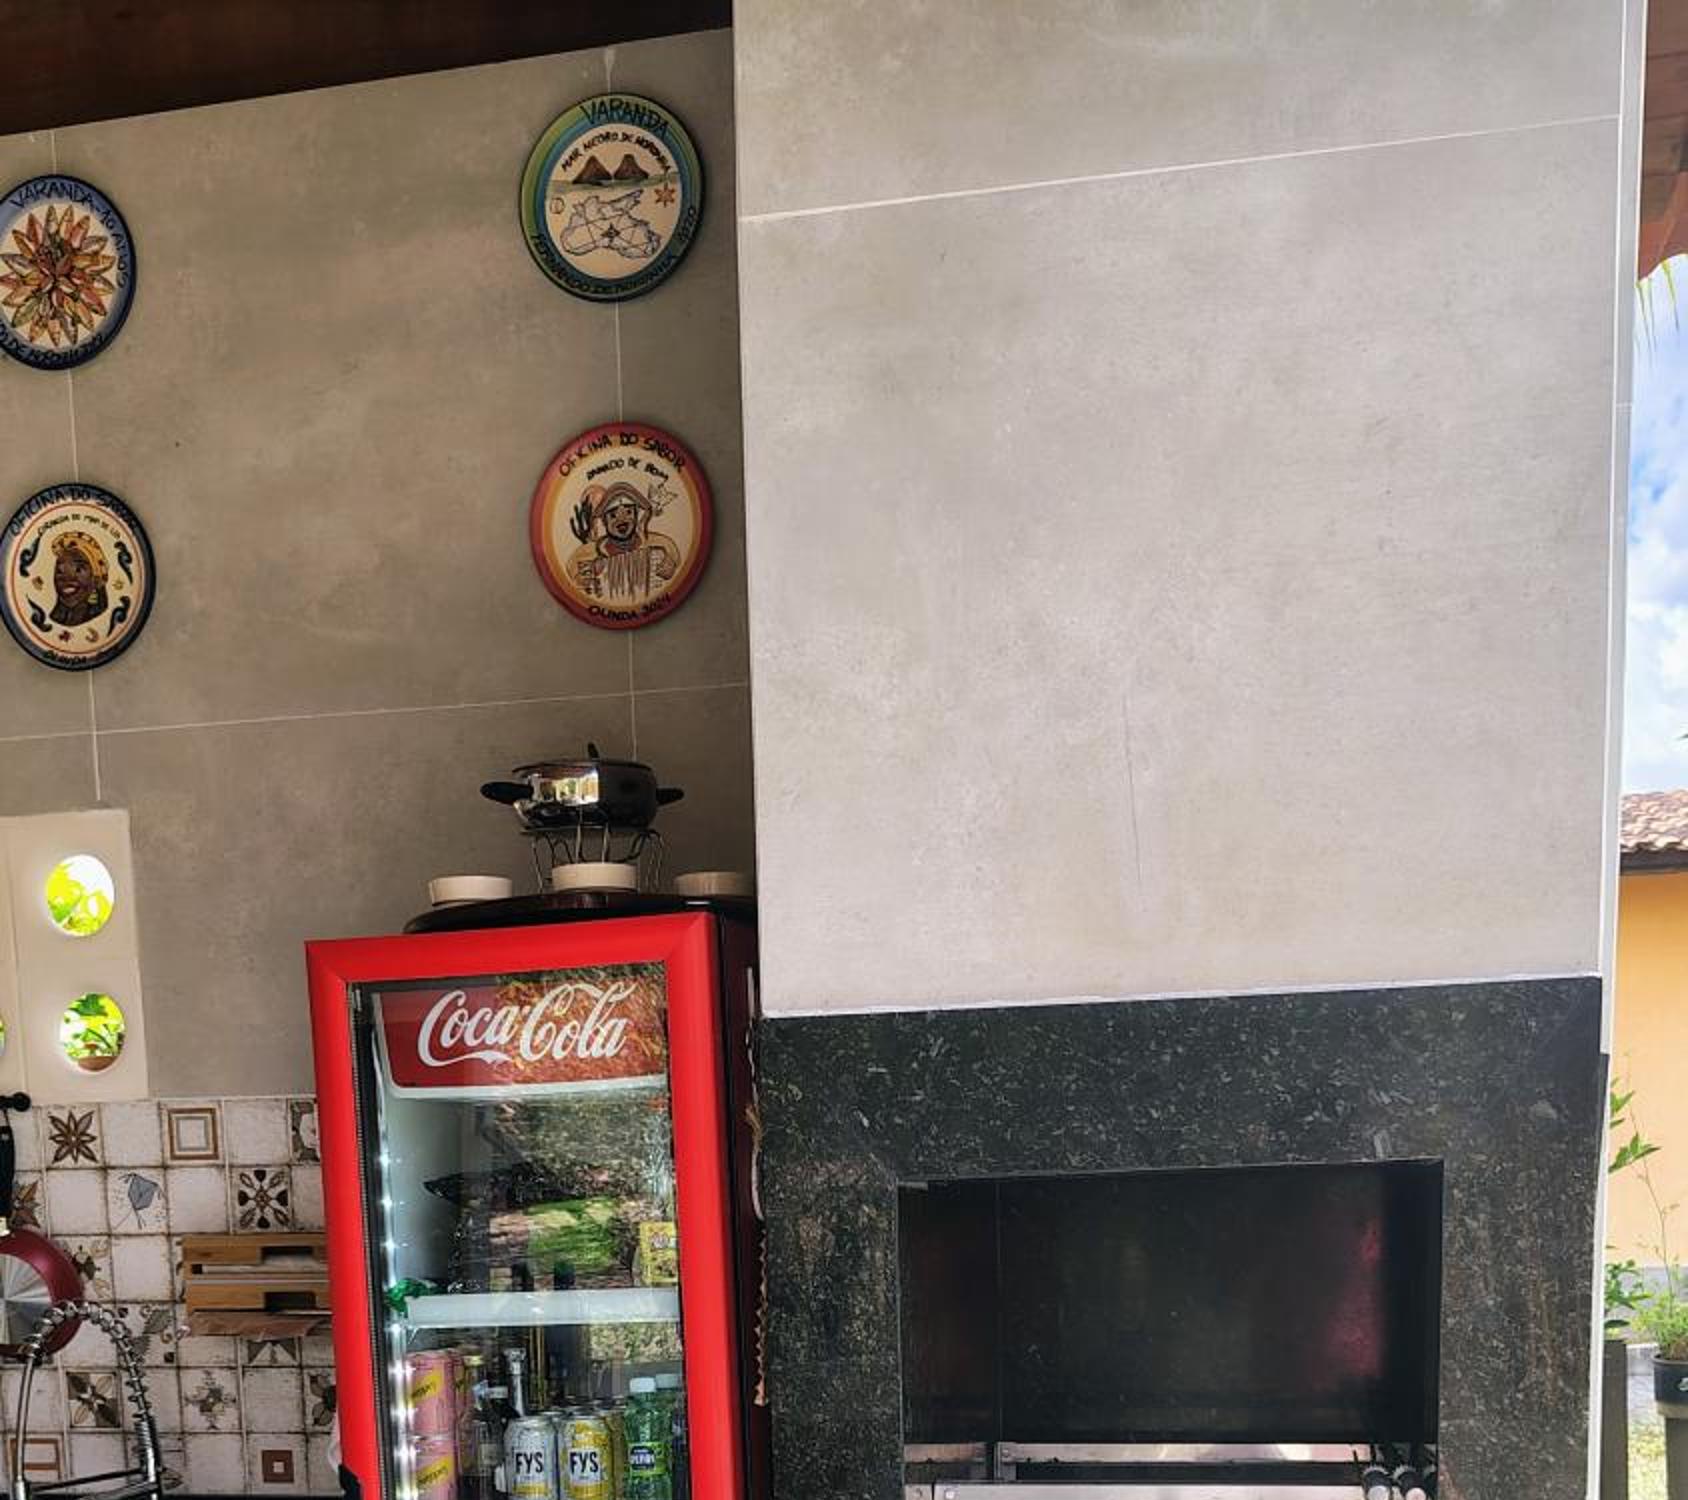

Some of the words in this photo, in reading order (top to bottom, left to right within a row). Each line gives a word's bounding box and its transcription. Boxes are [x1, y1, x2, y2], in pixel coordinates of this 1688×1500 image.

[580, 98, 671, 138] VARANDA
[558, 434, 613, 477] OFICINA
[619, 432, 639, 446] DO
[643, 437, 685, 474] SABOR
[588, 604, 640, 621] OLINDA
[515, 1451, 545, 1474] FYS
[570, 1450, 600, 1474] FYS
